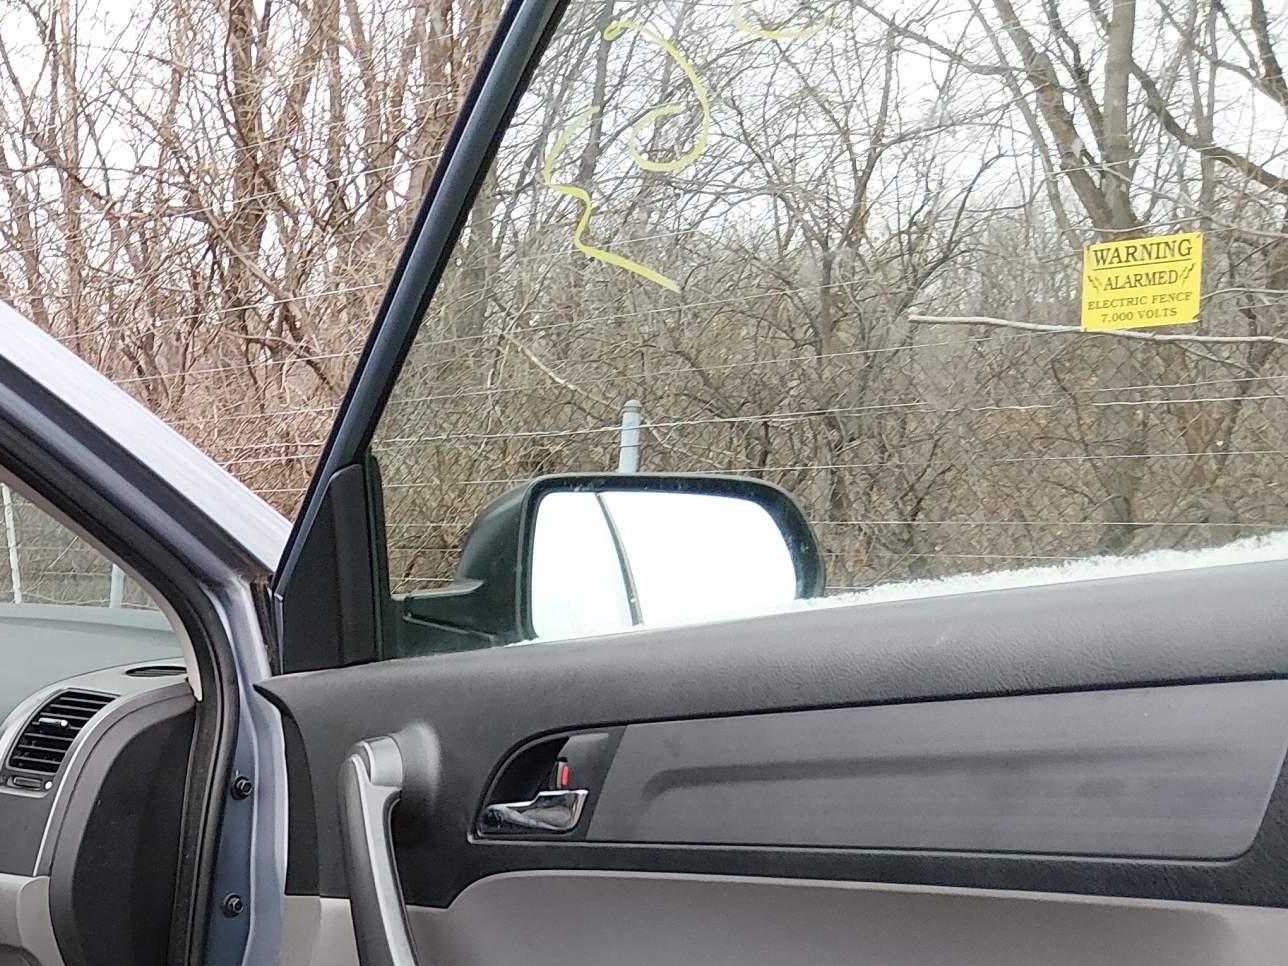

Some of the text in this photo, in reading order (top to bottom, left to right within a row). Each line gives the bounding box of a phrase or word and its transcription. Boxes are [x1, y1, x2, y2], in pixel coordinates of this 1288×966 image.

[1092, 239, 1193, 267] WARNING
[1103, 269, 1179, 291] ALARMED
[1087, 291, 1193, 311] ELECTRIC FENCE
[1137, 307, 1178, 320] VOLTS
